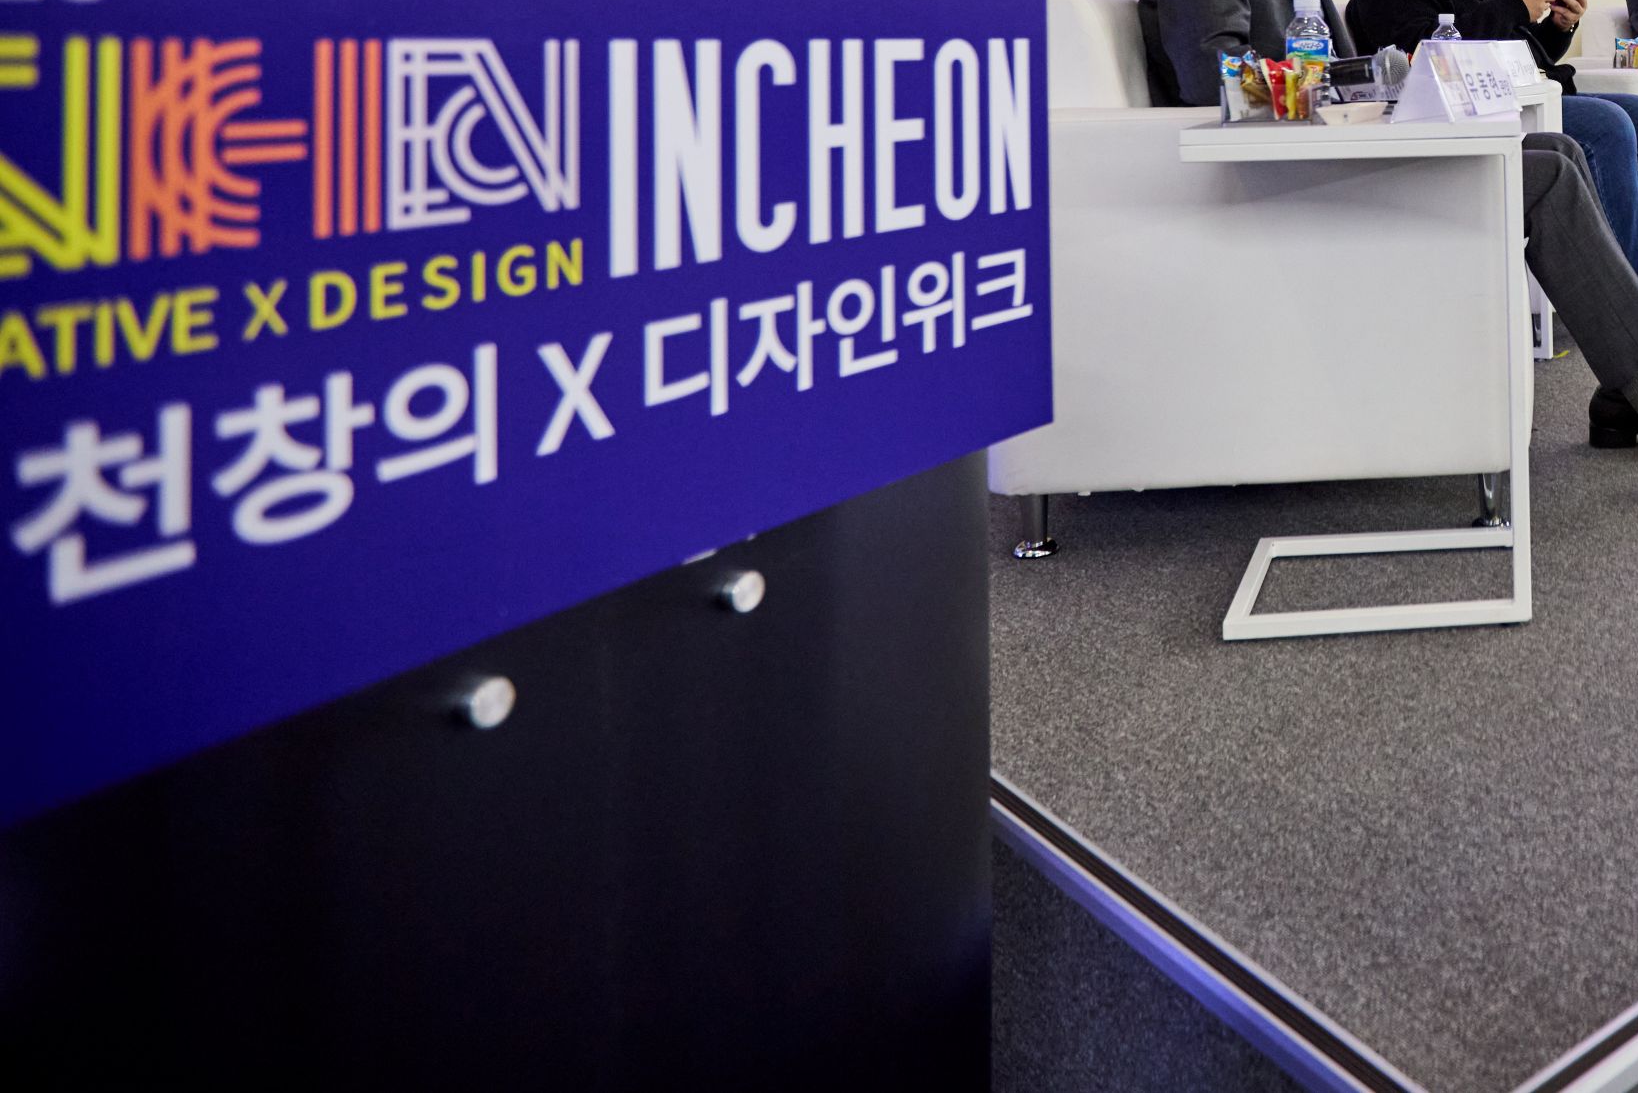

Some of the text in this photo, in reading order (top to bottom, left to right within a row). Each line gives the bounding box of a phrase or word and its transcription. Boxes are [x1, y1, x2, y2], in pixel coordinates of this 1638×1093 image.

[607, 36, 1032, 280] INCHEON
[242, 279, 288, 343] X
[308, 237, 586, 332] DESIGN
[10, 245, 1033, 607] 천창의 X 디자인위크
